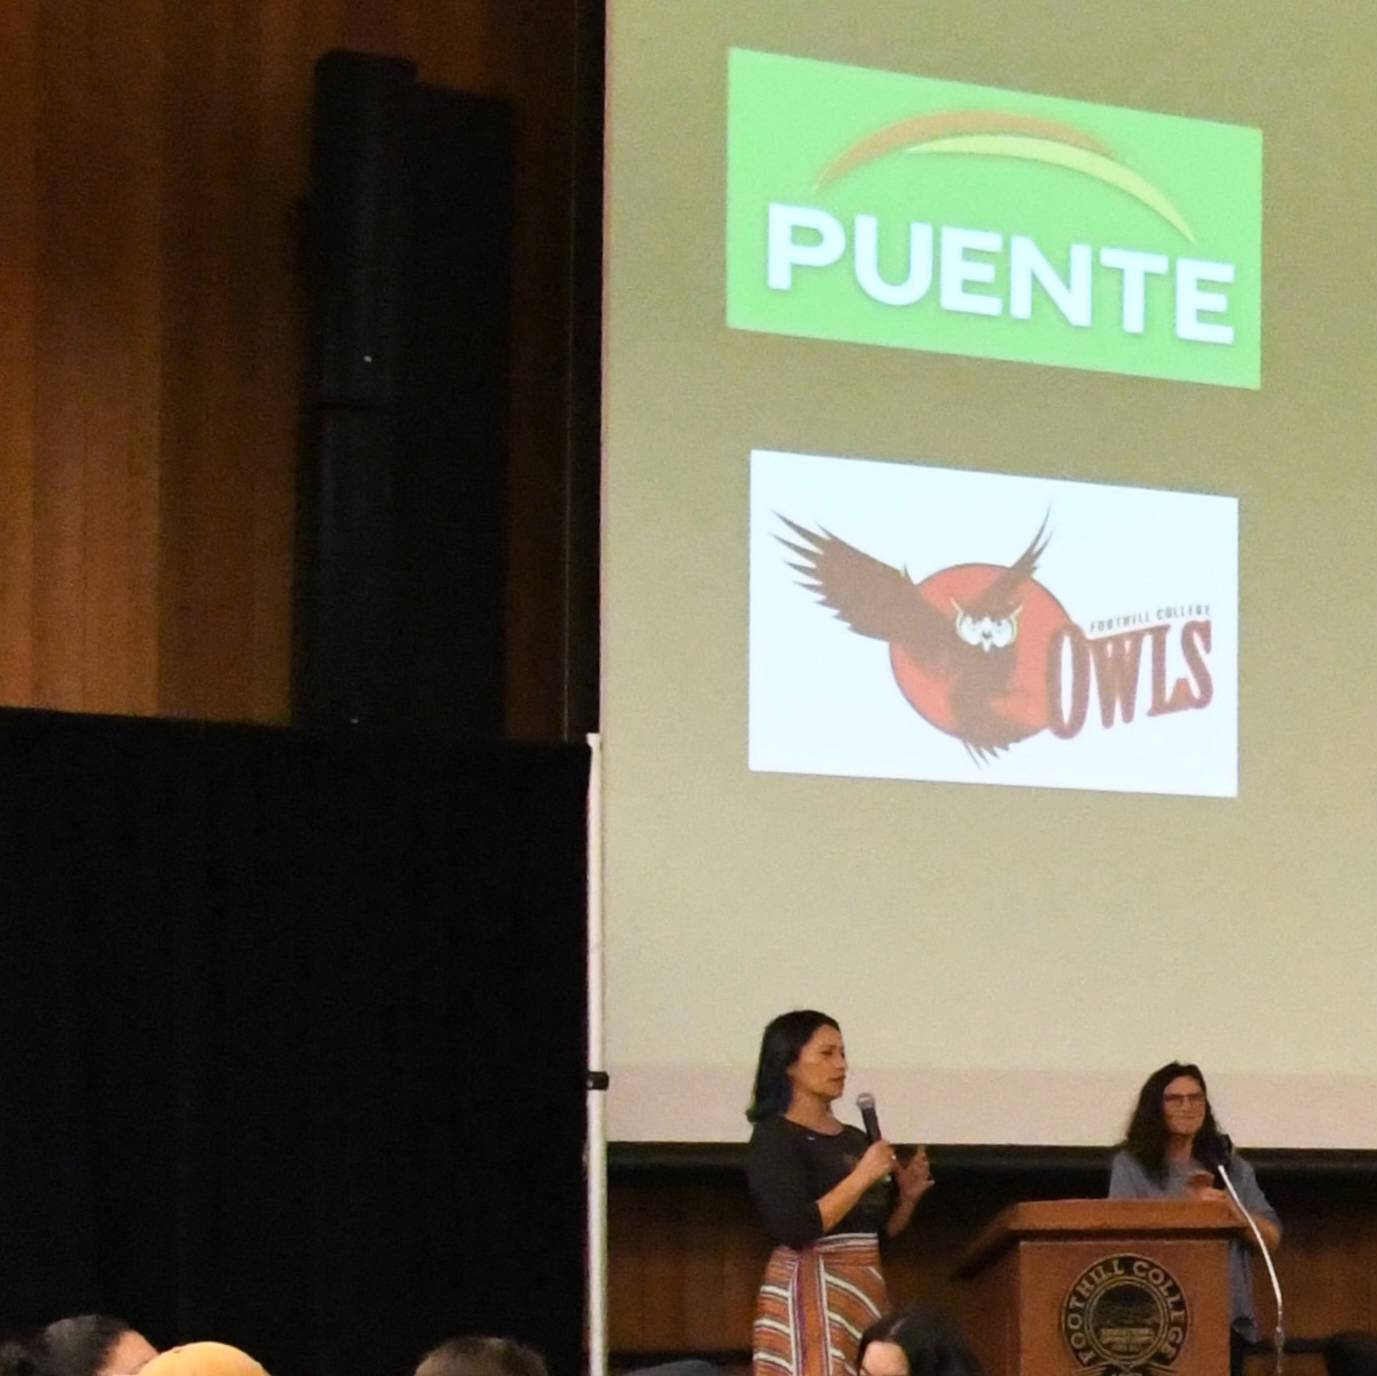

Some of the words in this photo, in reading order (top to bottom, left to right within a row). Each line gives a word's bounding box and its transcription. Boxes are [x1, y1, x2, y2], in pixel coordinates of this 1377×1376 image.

[766, 202, 1235, 344] PUENTE
[1046, 620, 1213, 739] OWLS
[1066, 1259, 1125, 1364] FOOTHILL
[1132, 1260, 1185, 1360] COLLEGE
